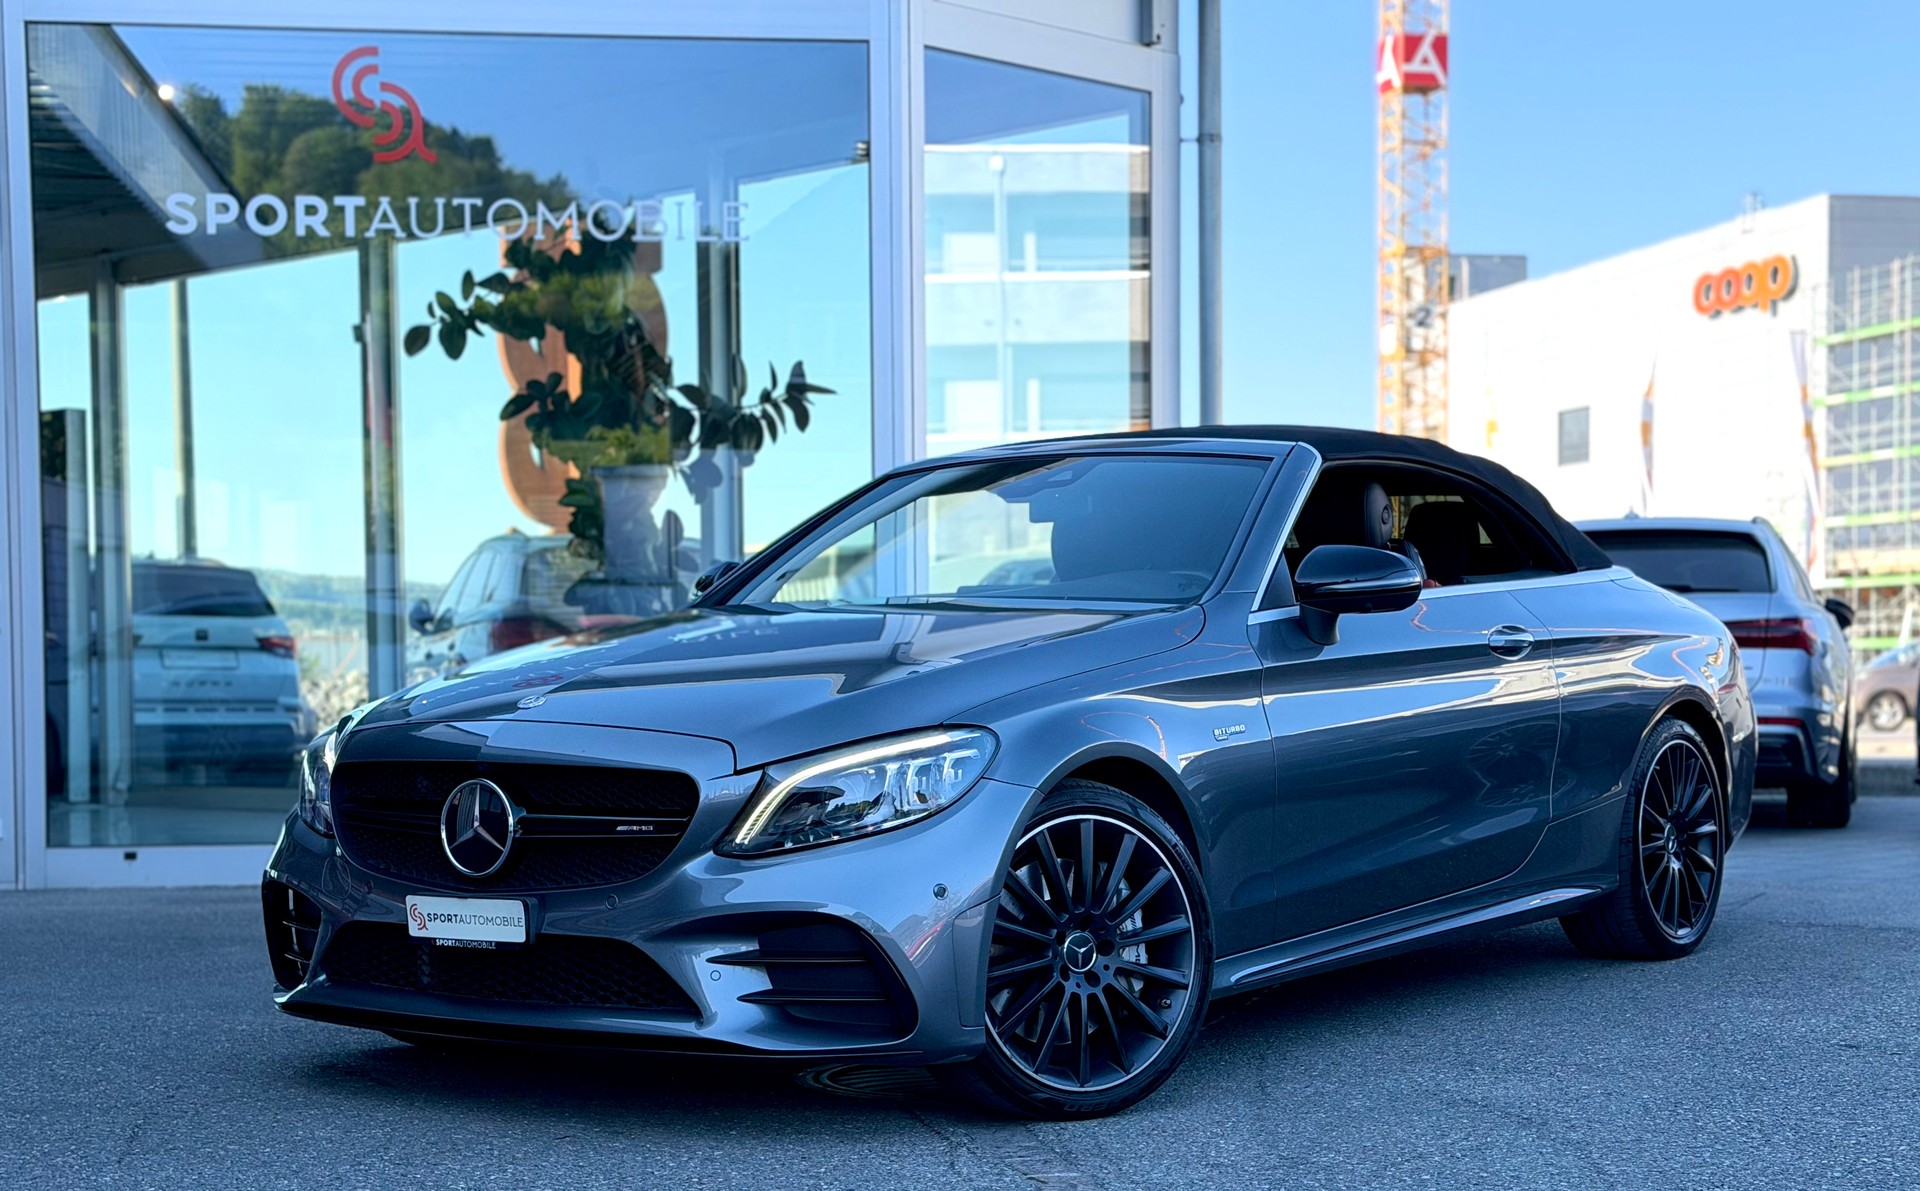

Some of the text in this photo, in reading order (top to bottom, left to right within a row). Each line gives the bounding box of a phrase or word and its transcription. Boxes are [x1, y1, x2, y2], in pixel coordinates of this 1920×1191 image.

[165, 192, 749, 241] SPORTAUTOMOBILE
[1693, 254, 1794, 315] coop
[1213, 724, 1246, 736] BITURBO
[426, 912, 524, 928] SPORTAUTOMOBILE
[435, 938, 496, 949] SPORTAUTOMOBILE
